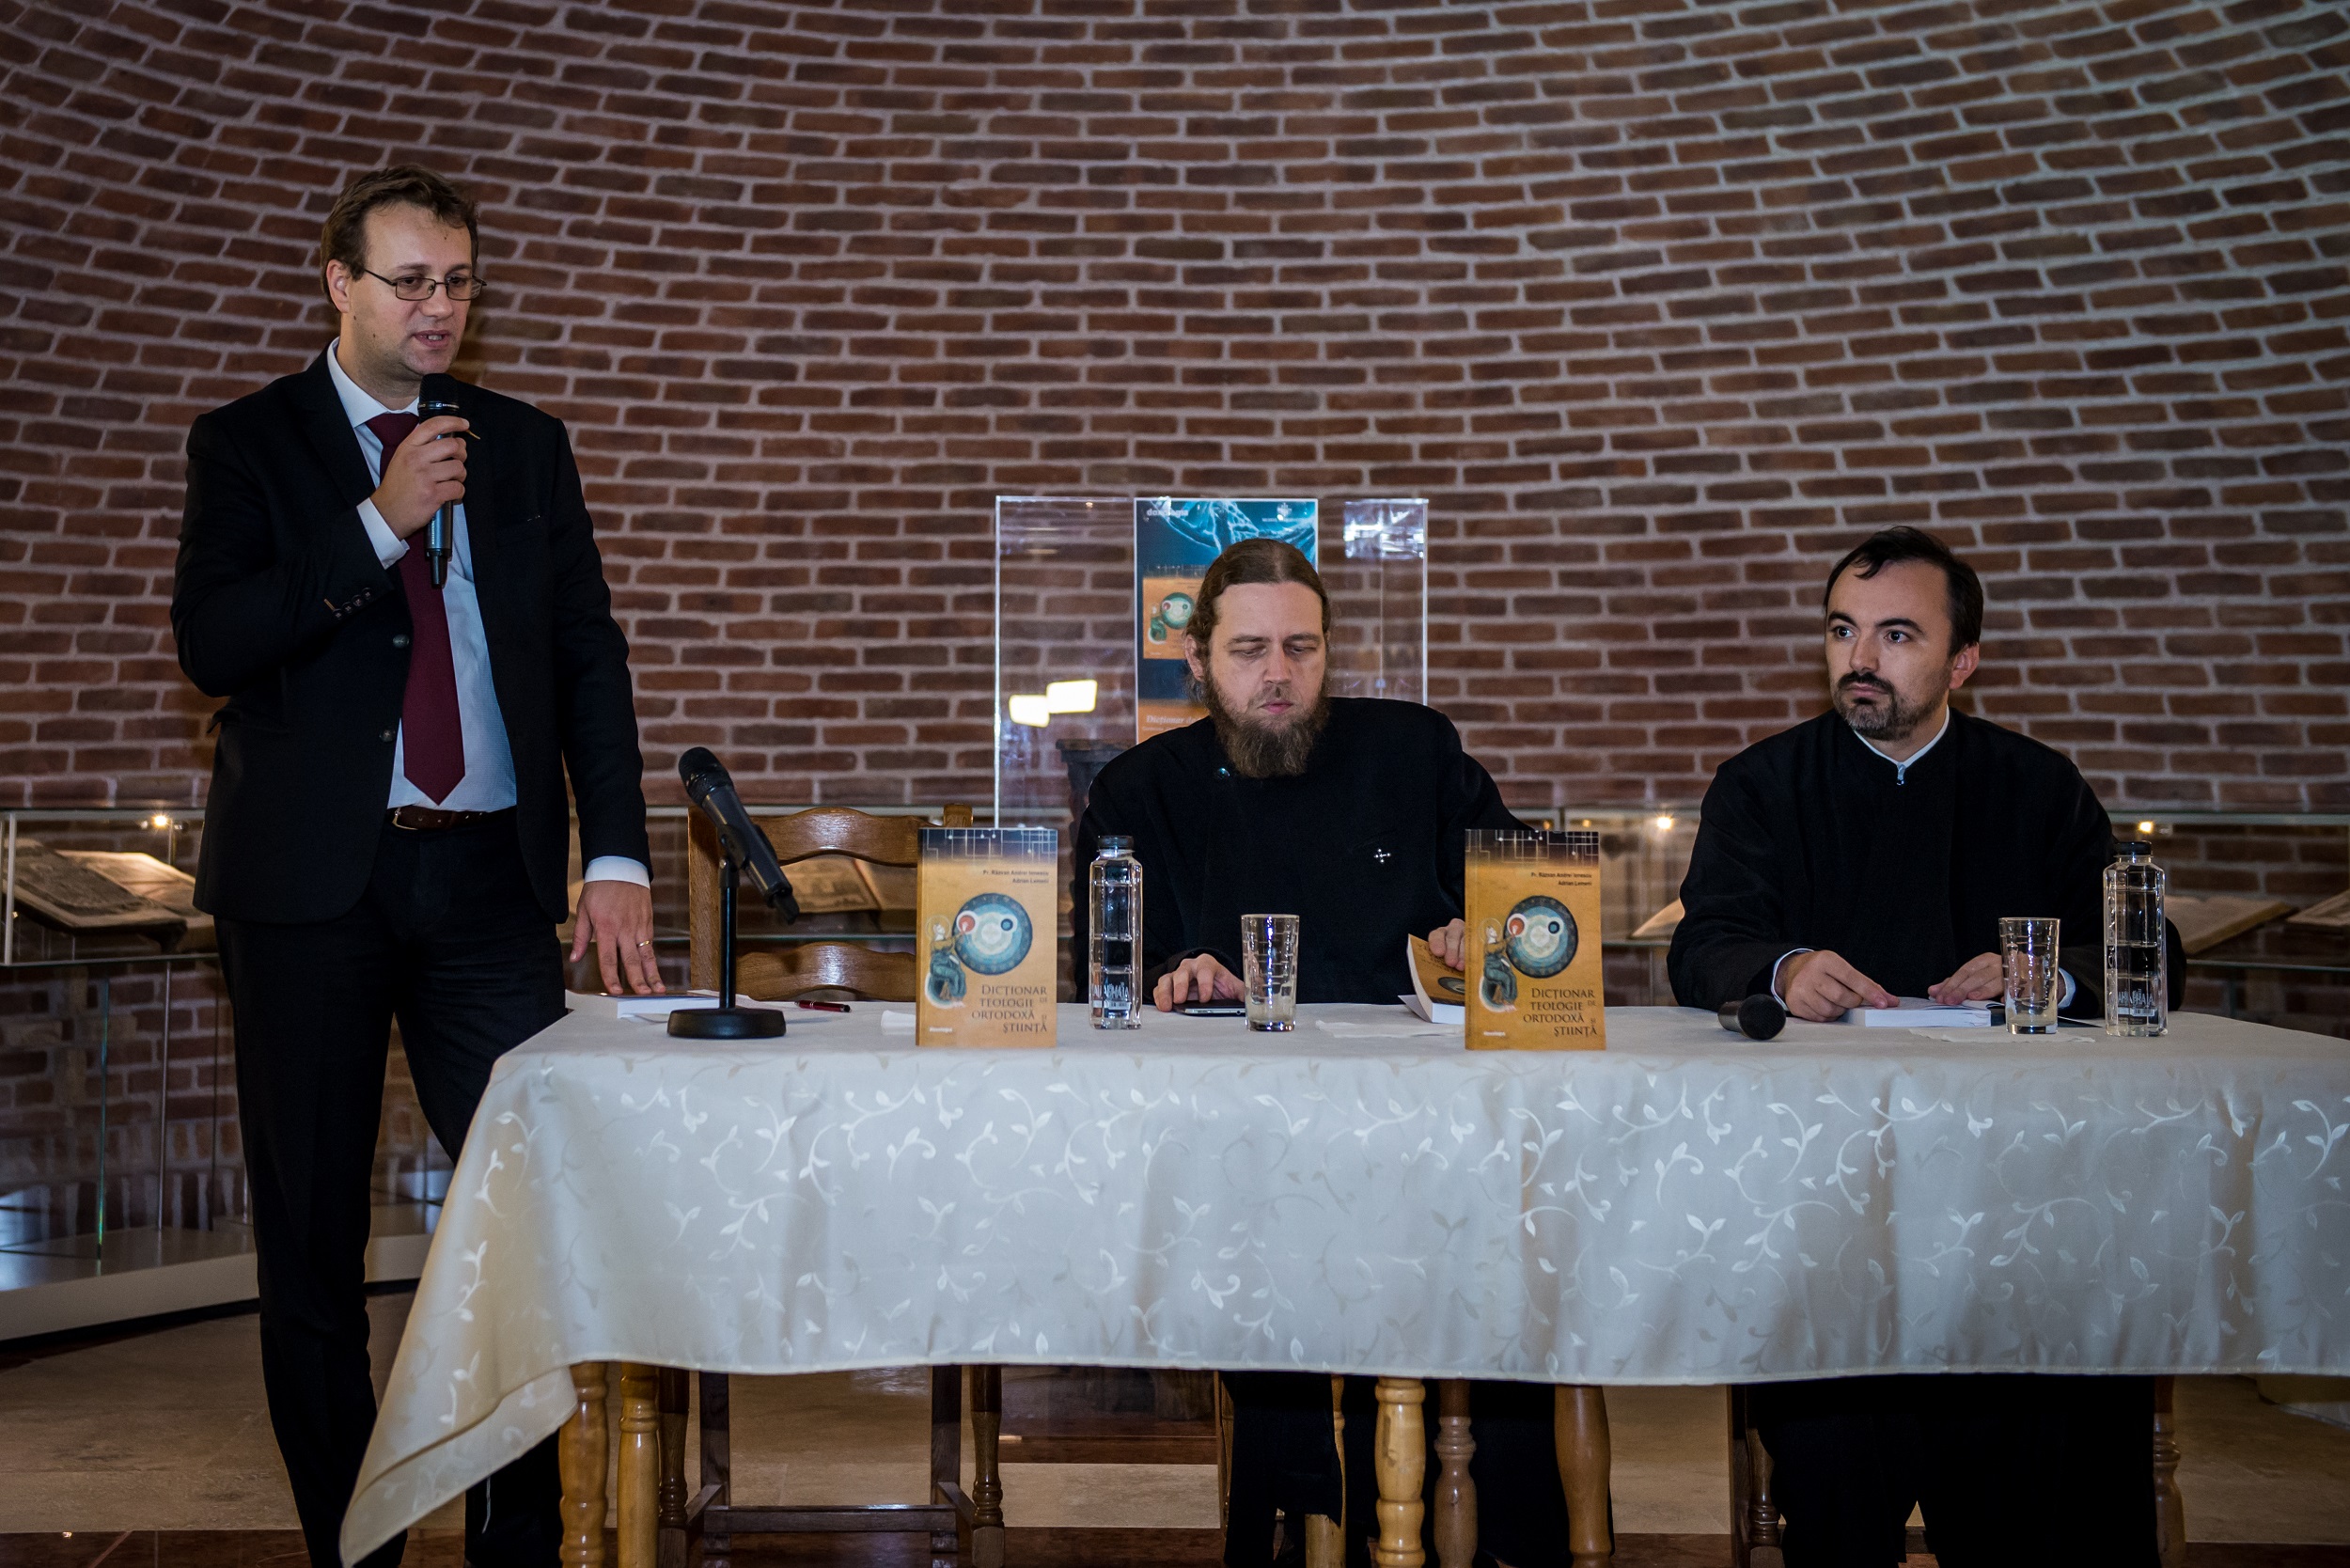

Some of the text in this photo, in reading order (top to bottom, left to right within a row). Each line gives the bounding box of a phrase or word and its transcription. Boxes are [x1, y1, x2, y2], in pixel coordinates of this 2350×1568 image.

[1531, 988, 1595, 999] DICȚIONAR
[979, 997, 1033, 1008] TEOLOGIE
[1530, 1001, 1584, 1011] TEOLOGIE
[971, 1009, 1035, 1020] ORTODOXĂ
[1523, 1012, 1585, 1023] ORTODOXĂ
